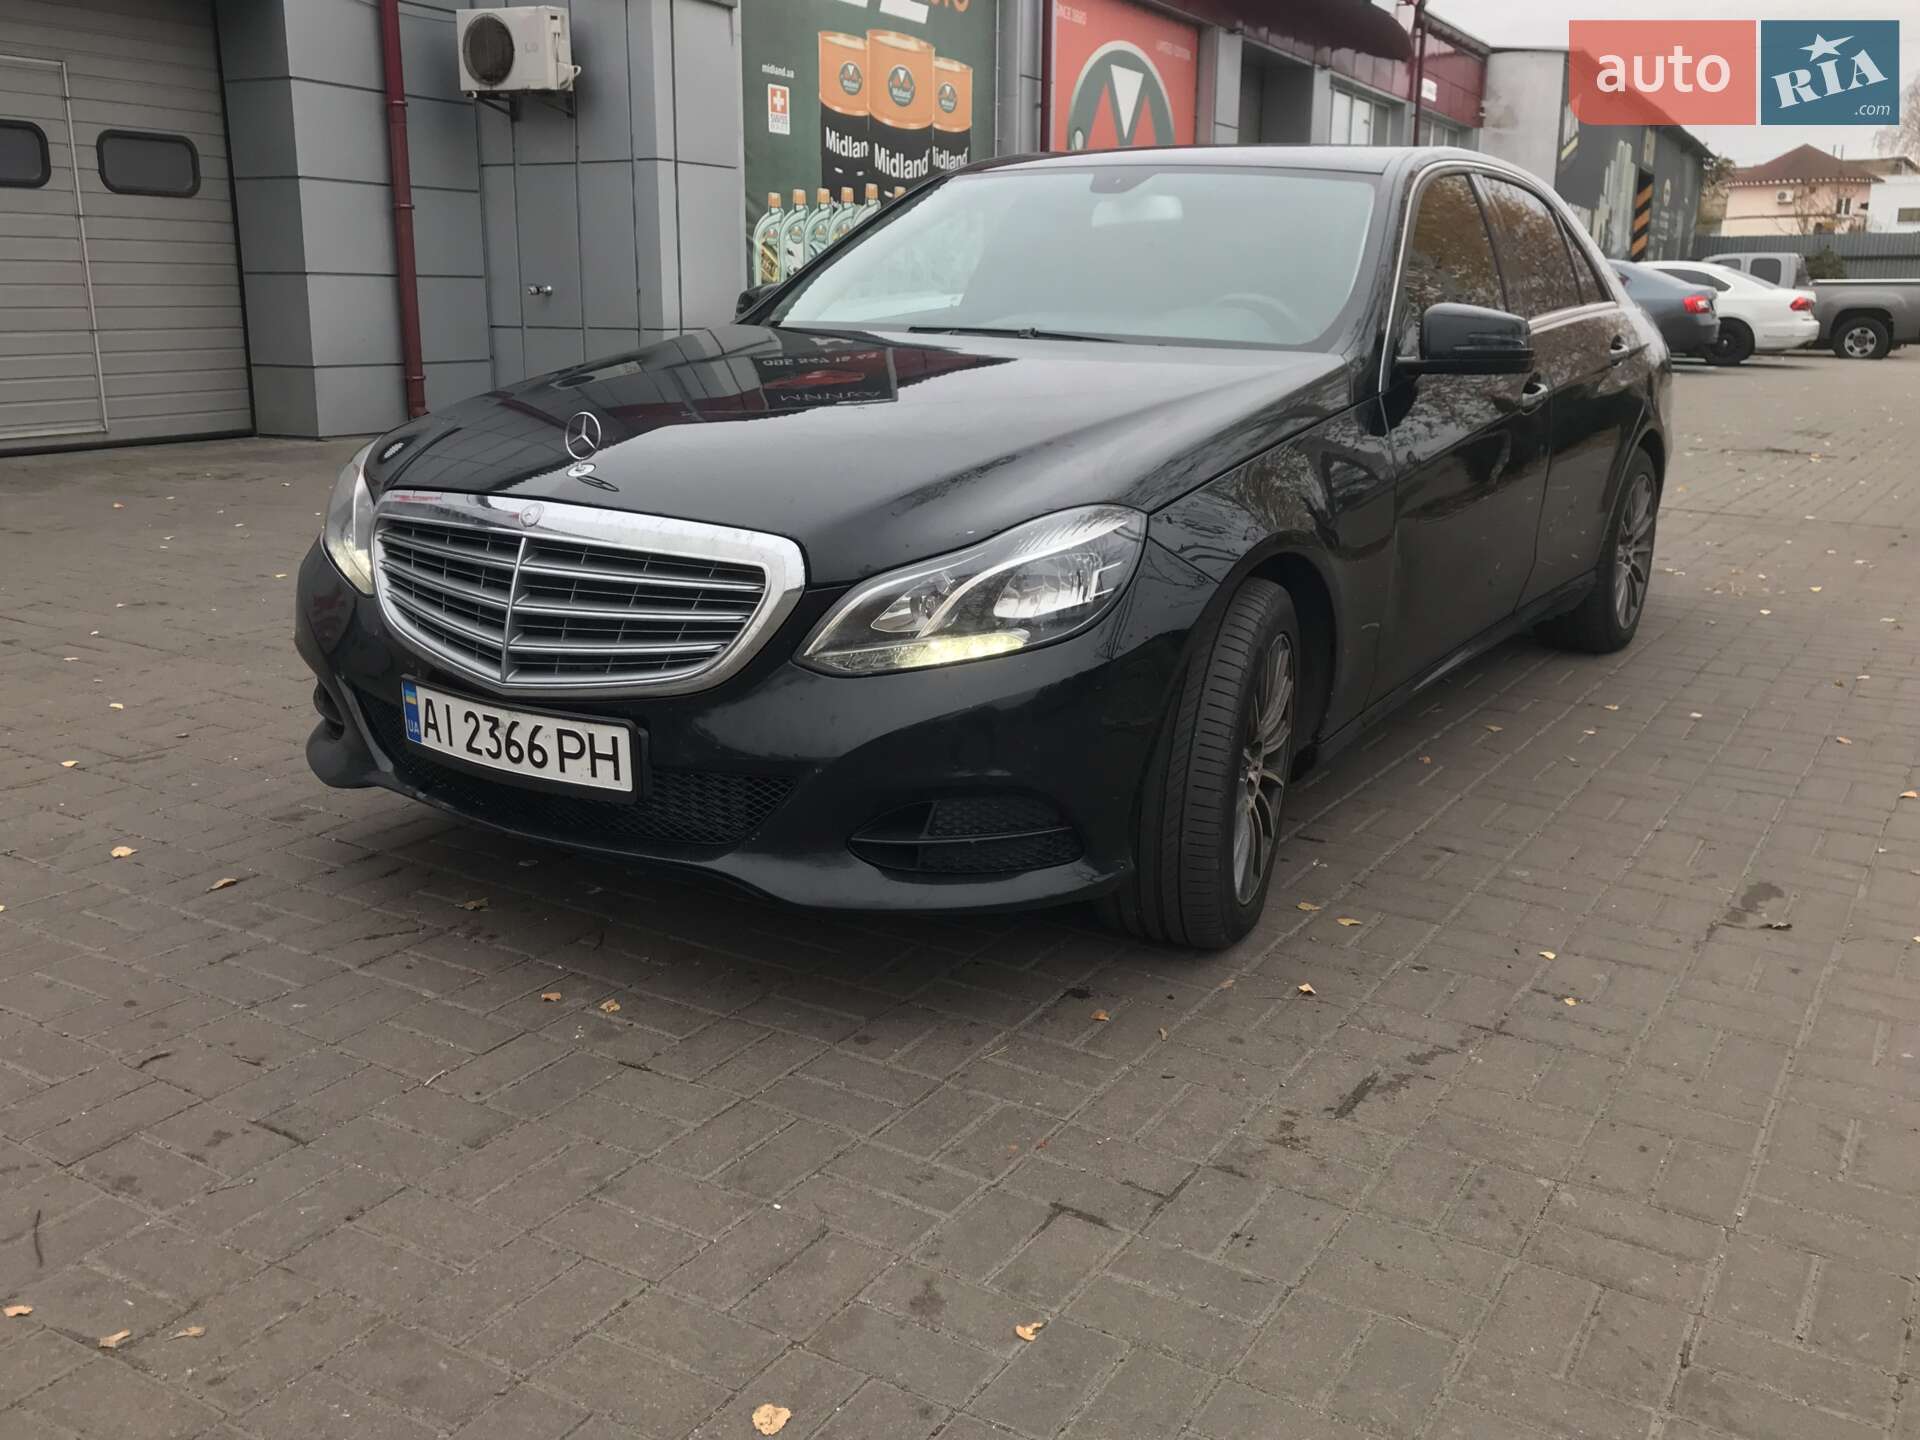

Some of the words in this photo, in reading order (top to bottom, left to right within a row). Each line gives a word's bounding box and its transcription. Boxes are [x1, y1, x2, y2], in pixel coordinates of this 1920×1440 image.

[761, 63, 795, 79] midland.ua
[874, 142, 930, 179] Midland
[409, 720, 420, 734] UA
[424, 698, 453, 747] AI
[464, 711, 549, 769] 2366
[556, 728, 621, 781] PH
